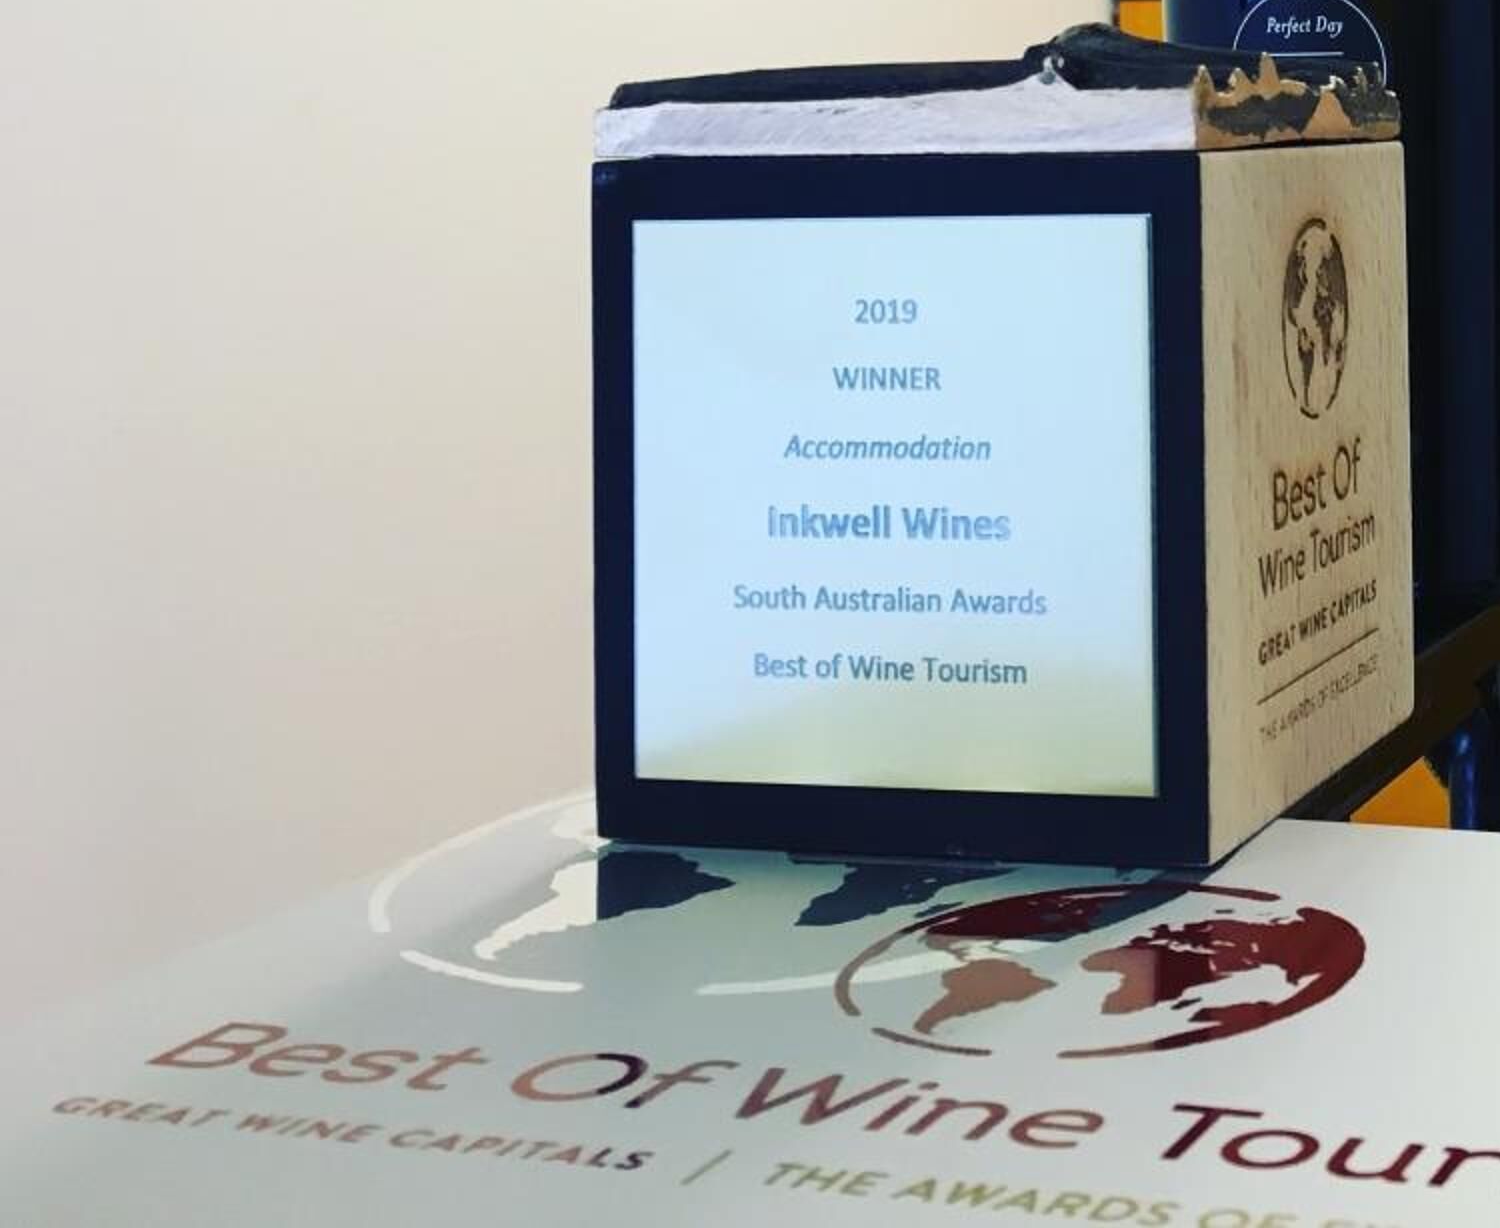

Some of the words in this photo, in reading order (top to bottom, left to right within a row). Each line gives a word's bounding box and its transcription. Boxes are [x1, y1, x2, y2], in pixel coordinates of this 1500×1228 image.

[1266, 16, 1312, 39] Perfect
[1315, 15, 1344, 39] Day
[854, 299, 918, 325] 2019
[832, 367, 942, 392] WINNER
[783, 434, 992, 461] Accommodation
[1271, 462, 1327, 530] Best
[1332, 436, 1362, 501] Of
[766, 504, 891, 540] Inkwell
[901, 507, 1011, 541] Wines
[1258, 546, 1306, 598] Wine
[1310, 512, 1376, 574] Tourism
[733, 584, 806, 610] South
[814, 586, 942, 614] Australian
[950, 589, 1048, 615] Awards
[1257, 623, 1297, 667] GREAT
[1299, 607, 1329, 642] WINE
[1329, 579, 1378, 626] CAPITALS
[753, 653, 808, 679] Best
[815, 653, 843, 680] of
[847, 654, 915, 683] Wine
[922, 657, 1028, 685] Tourism
[145, 1021, 490, 1091] Best
[509, 1052, 738, 1110] Of
[735, 1066, 1105, 1150] Wine
[52, 1096, 231, 1128] GREAT
[235, 1113, 387, 1144] WINE
[388, 1129, 653, 1171] CAPITALS
[763, 1162, 890, 1197] THE
[890, 1178, 1181, 1227] AWARDS
